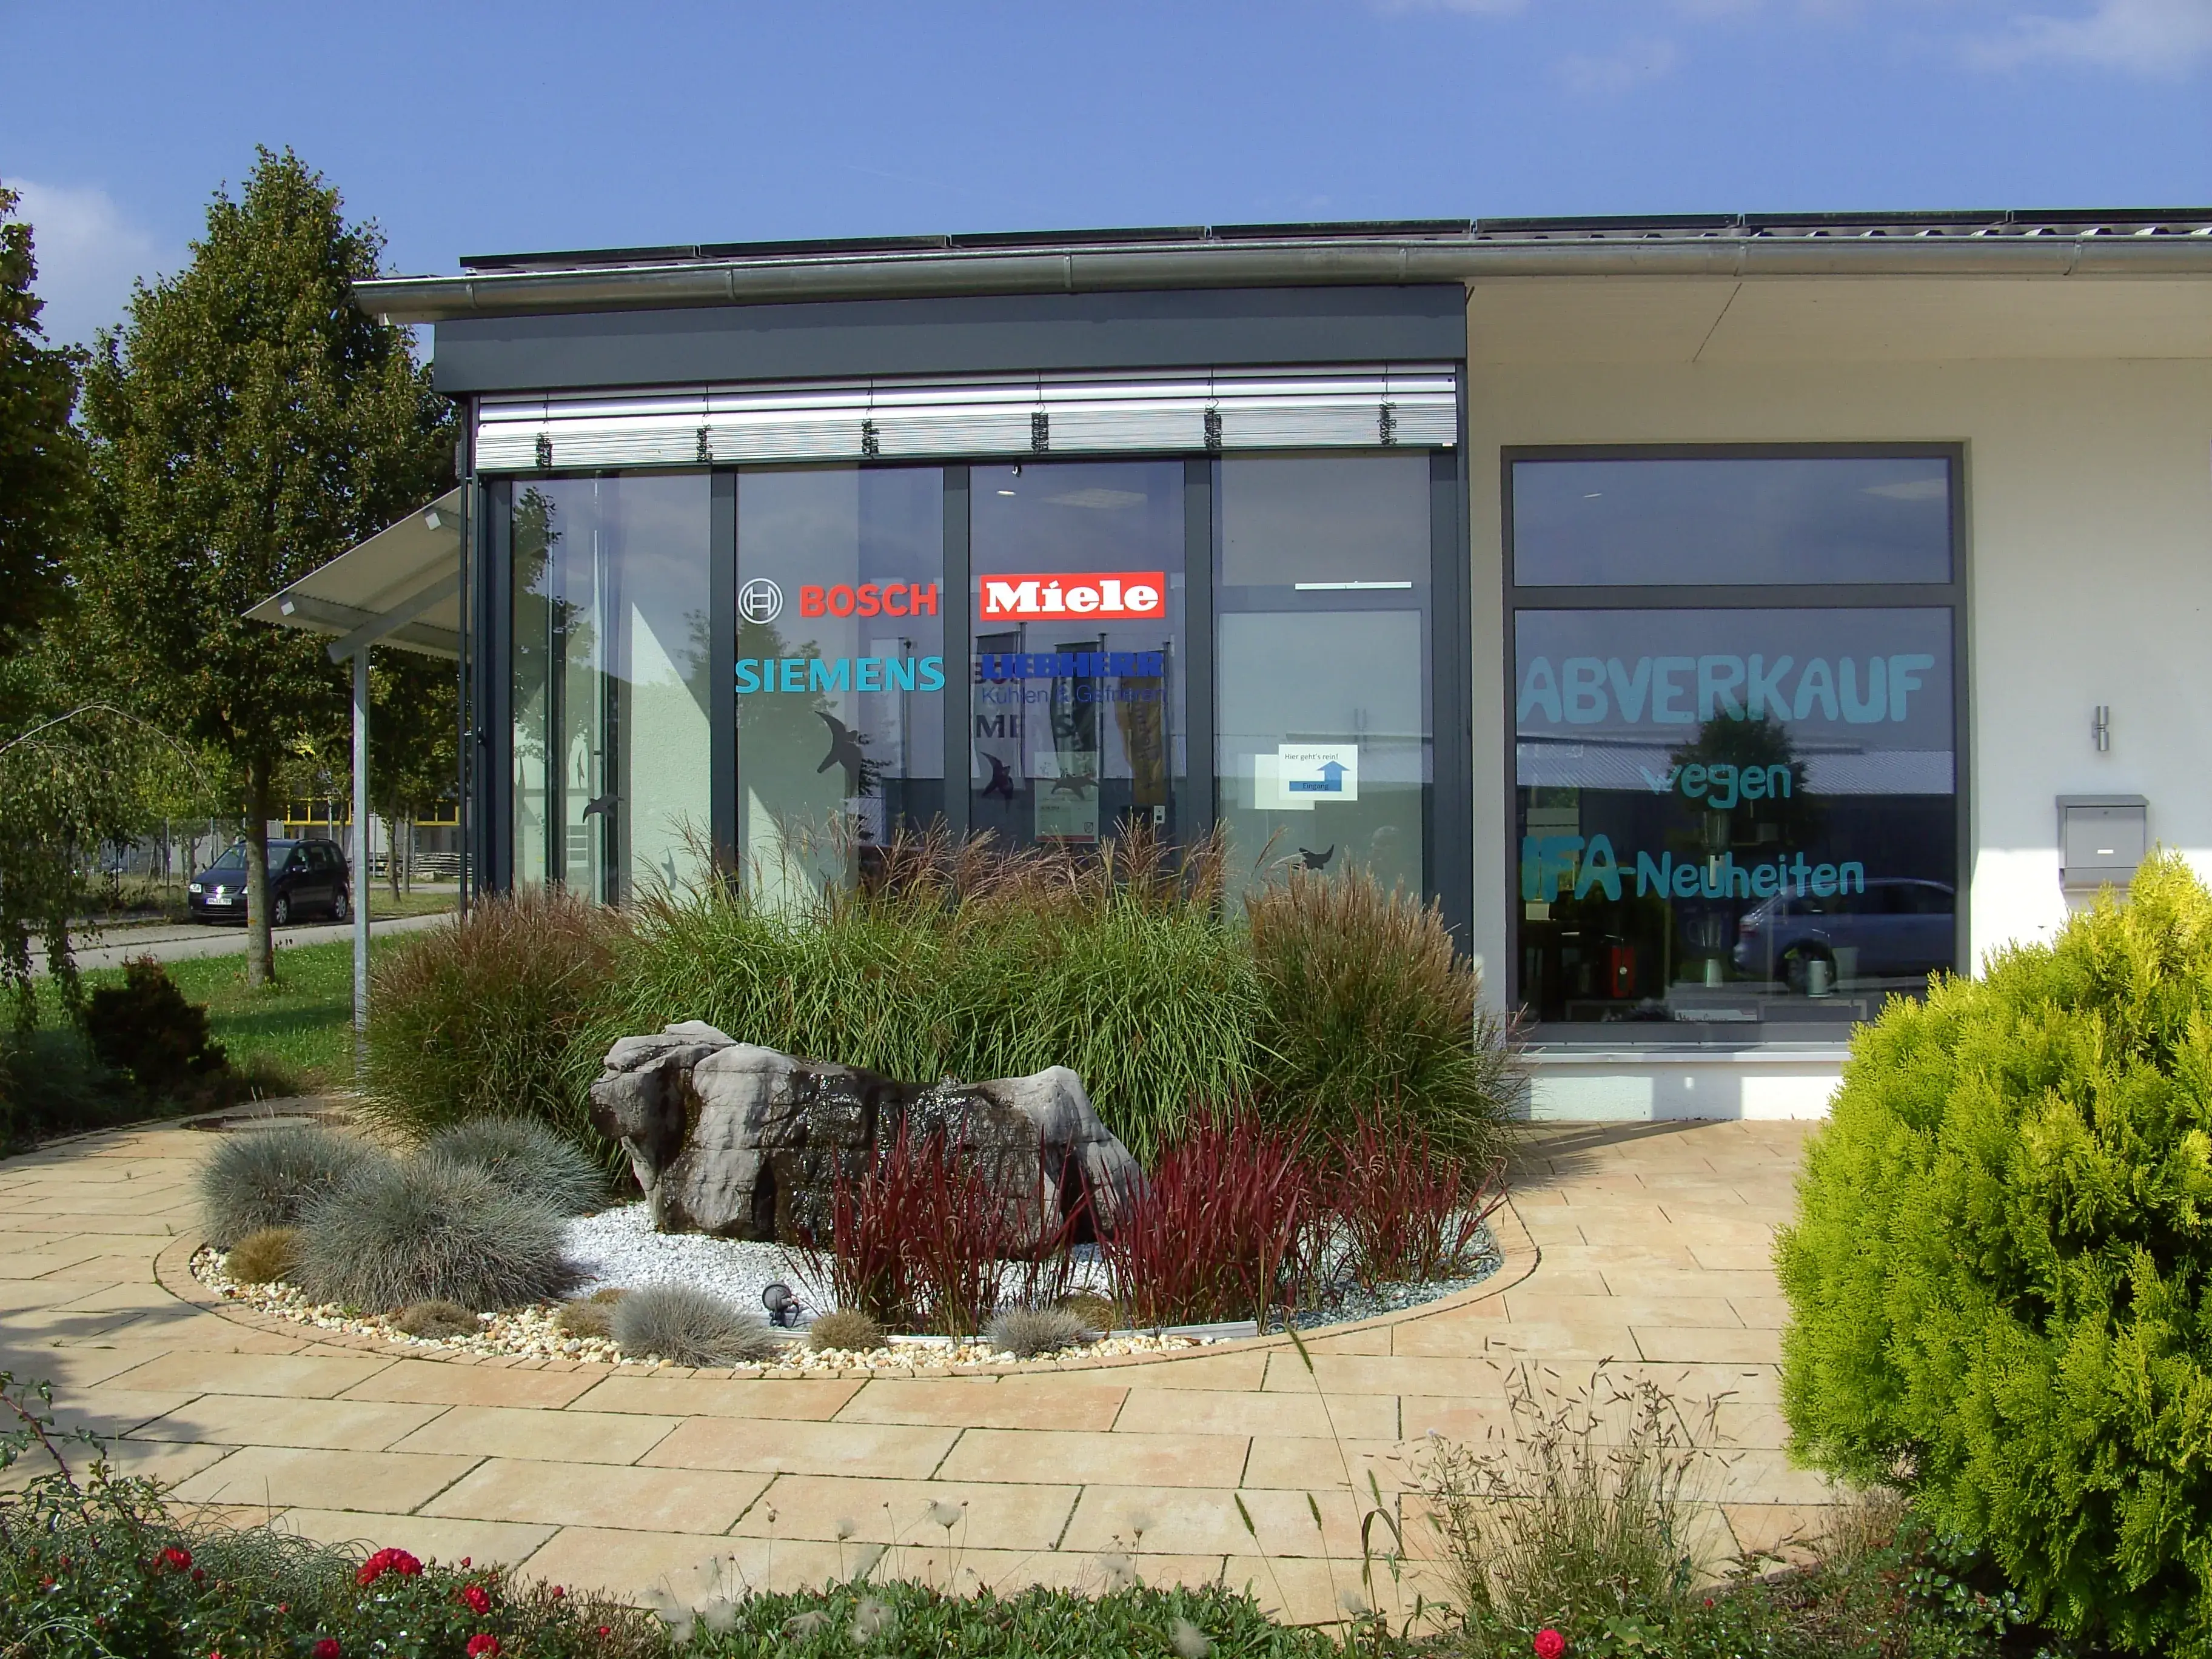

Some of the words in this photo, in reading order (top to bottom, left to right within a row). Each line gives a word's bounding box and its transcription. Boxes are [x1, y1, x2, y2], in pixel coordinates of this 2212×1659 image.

[800, 584, 937, 617] BOSCH
[986, 580, 1159, 613] Miele
[736, 656, 946, 694] SIEMENS
[982, 651, 1164, 679] LIEBHERR
[982, 685, 1048, 704] Kühlen
[1517, 654, 1935, 724] ABVERKAUF
[1302, 782, 1329, 791] Eingang
[1640, 763, 1791, 809] wegen
[1521, 833, 1865, 901] IFA-Neuheiten
